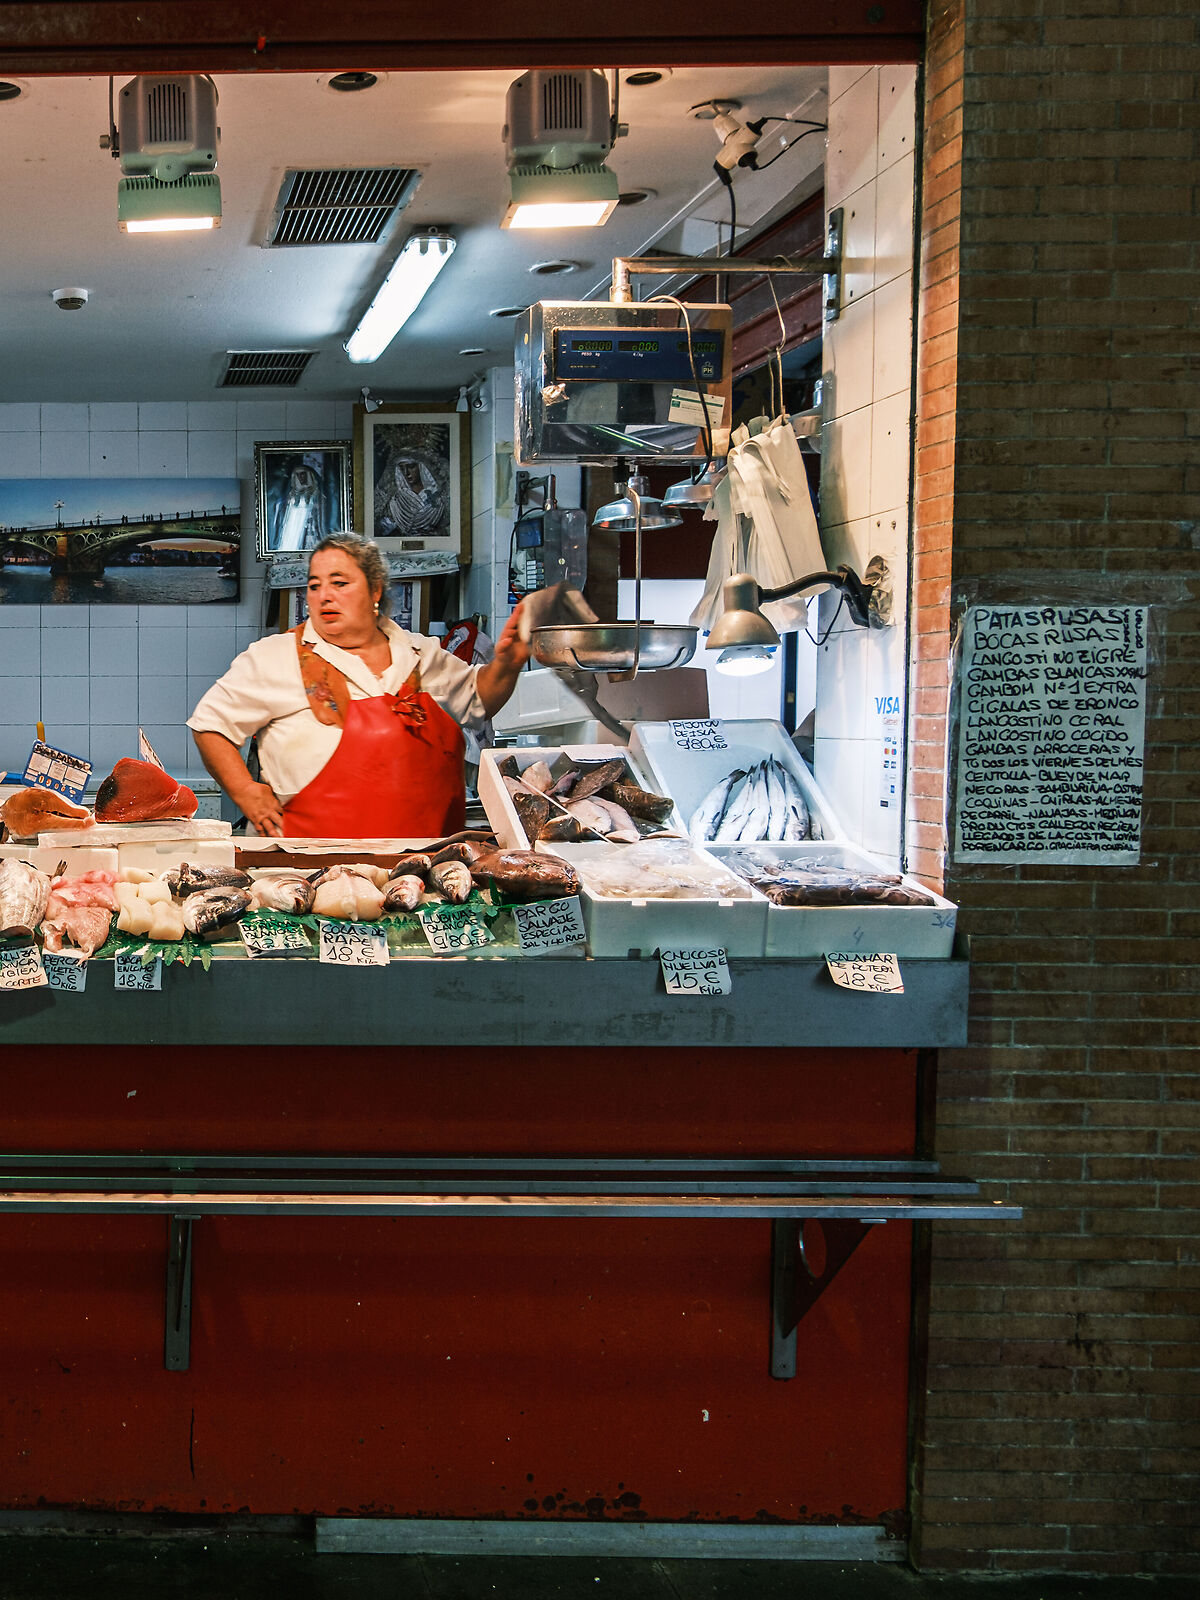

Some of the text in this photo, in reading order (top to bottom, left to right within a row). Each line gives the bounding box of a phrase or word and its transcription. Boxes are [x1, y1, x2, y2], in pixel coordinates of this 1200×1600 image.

[974, 608, 1124, 630] PATAS RUSAS
[974, 628, 1119, 650] BOCAS RUSAS
[968, 665, 1115, 682] GAMBAS BLANCAS
[1084, 681, 1138, 695] EXTRA
[874, 697, 900, 714] VISA
[968, 699, 1070, 714] CIGALAS DE
[968, 713, 1063, 728] LANGOSTINO
[966, 728, 1129, 742] LANGOSTINO COCIDO
[966, 743, 1027, 756] GAMBAS
[1033, 743, 1121, 755] ARROCERAS
[963, 756, 1143, 768] TODOS LOS VIERNES DEL MES
[1076, 771, 1095, 782] DE
[1098, 771, 1130, 783] MAR
[960, 810, 977, 820] DE
[978, 810, 1020, 820] CARRIL
[960, 820, 1035, 831] PRODUCTOS
[1038, 820, 1095, 830] GALLEGOS
[1028, 831, 1046, 840] DE
[1047, 832, 1064, 840] LA
[422, 909, 477, 925] LUBINAS
[515, 901, 570, 922] PARGO
[518, 912, 576, 933] SALVAJE
[322, 923, 386, 937] COLAS DE
[323, 932, 372, 946] RAPE
[327, 946, 375, 962] 18 €
[828, 952, 893, 964] CALAMAR
[67, 974, 77, 985] €
[118, 973, 153, 988] 18 €
[668, 971, 720, 989] 15 €
[838, 973, 890, 987] 18 €
